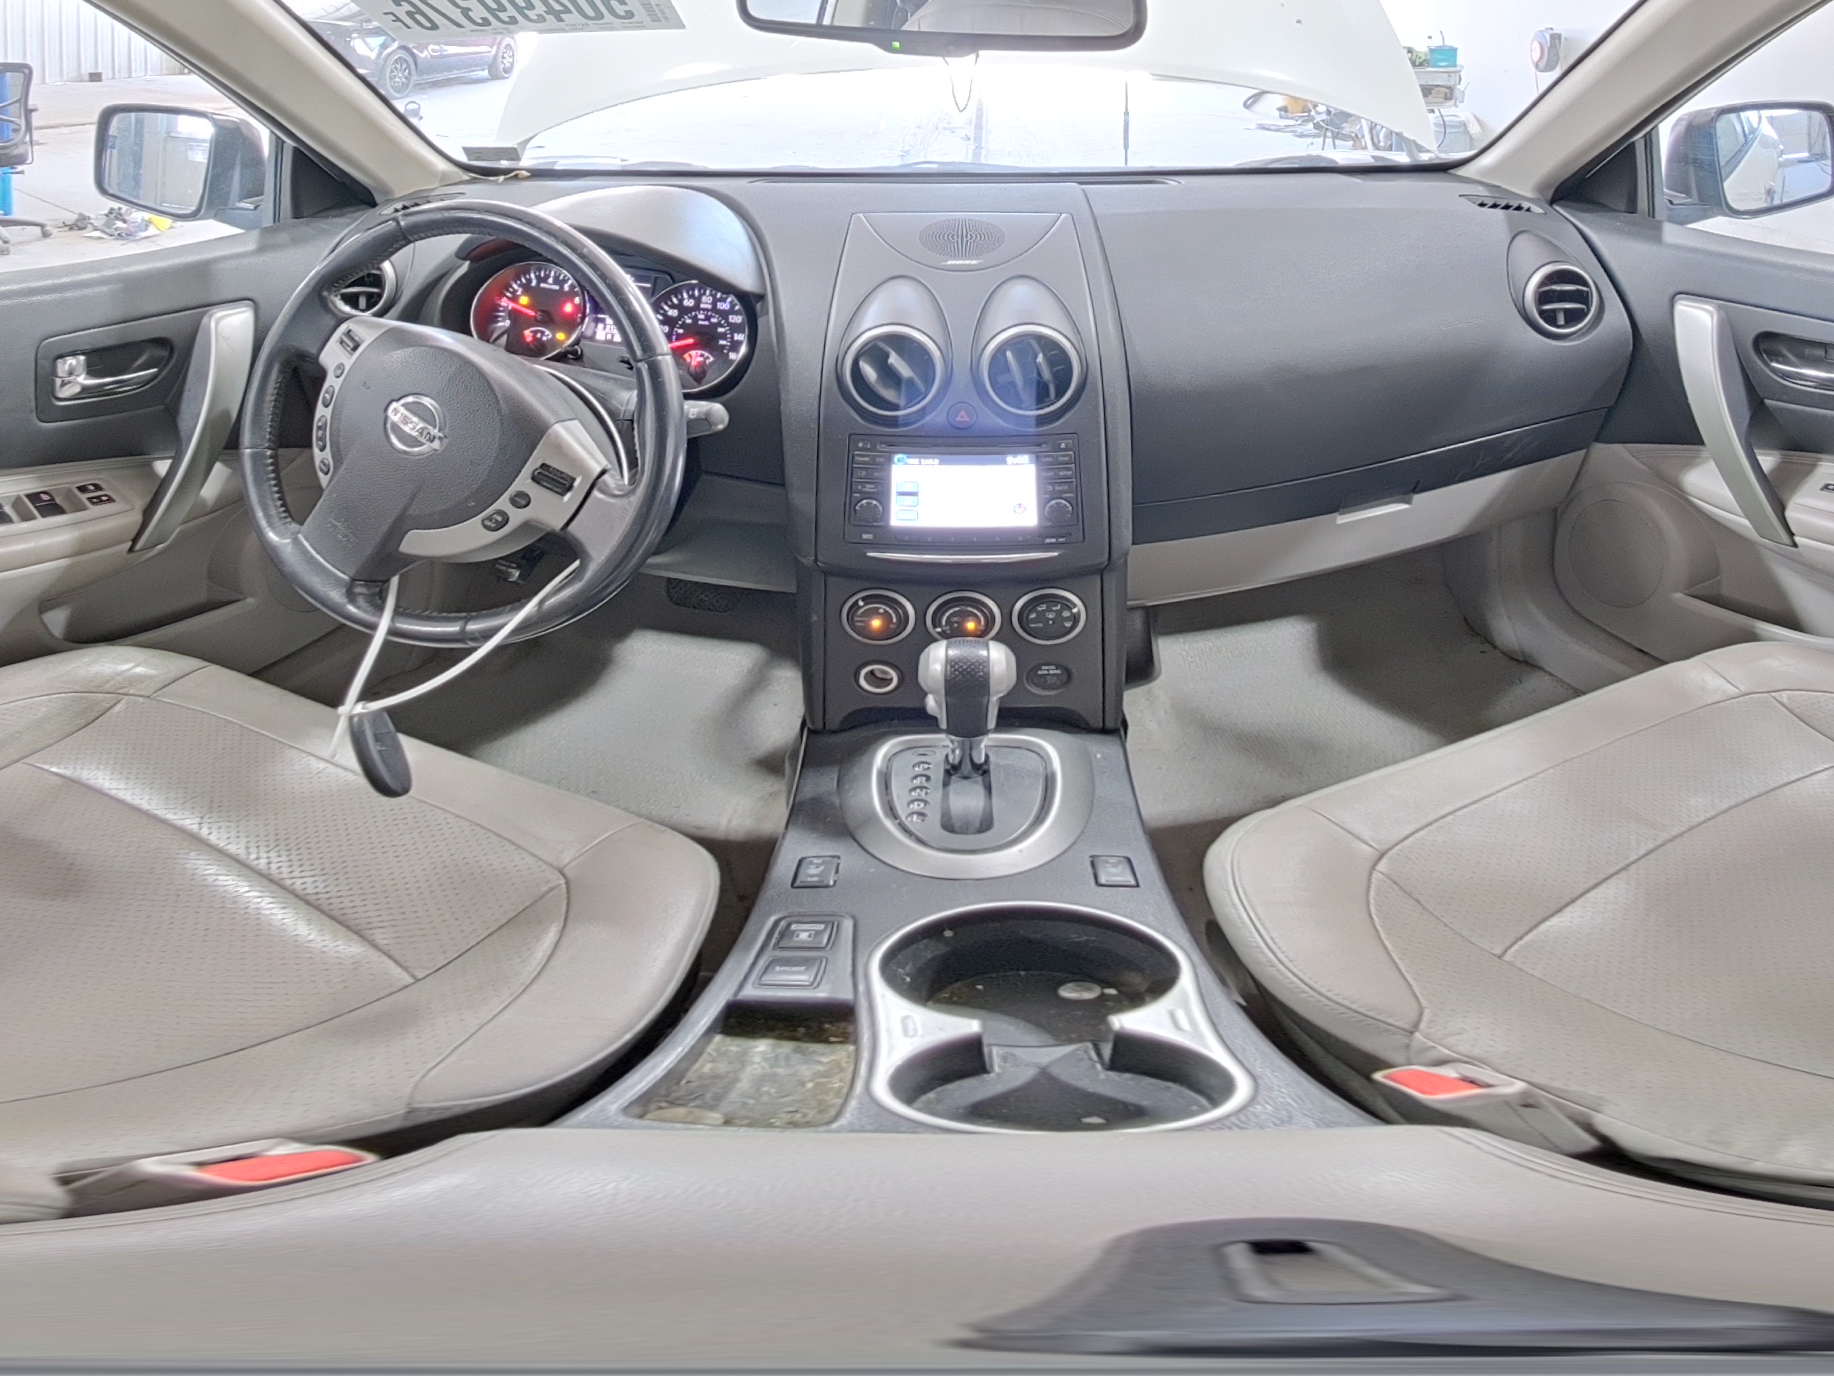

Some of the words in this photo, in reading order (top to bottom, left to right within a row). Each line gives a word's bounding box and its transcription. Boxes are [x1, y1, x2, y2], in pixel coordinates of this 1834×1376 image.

[683, 299, 695, 307] 60
[716, 302, 730, 310] 100
[667, 308, 679, 317] 40
[728, 314, 742, 323] 120
[391, 406, 437, 443] NISSAN
